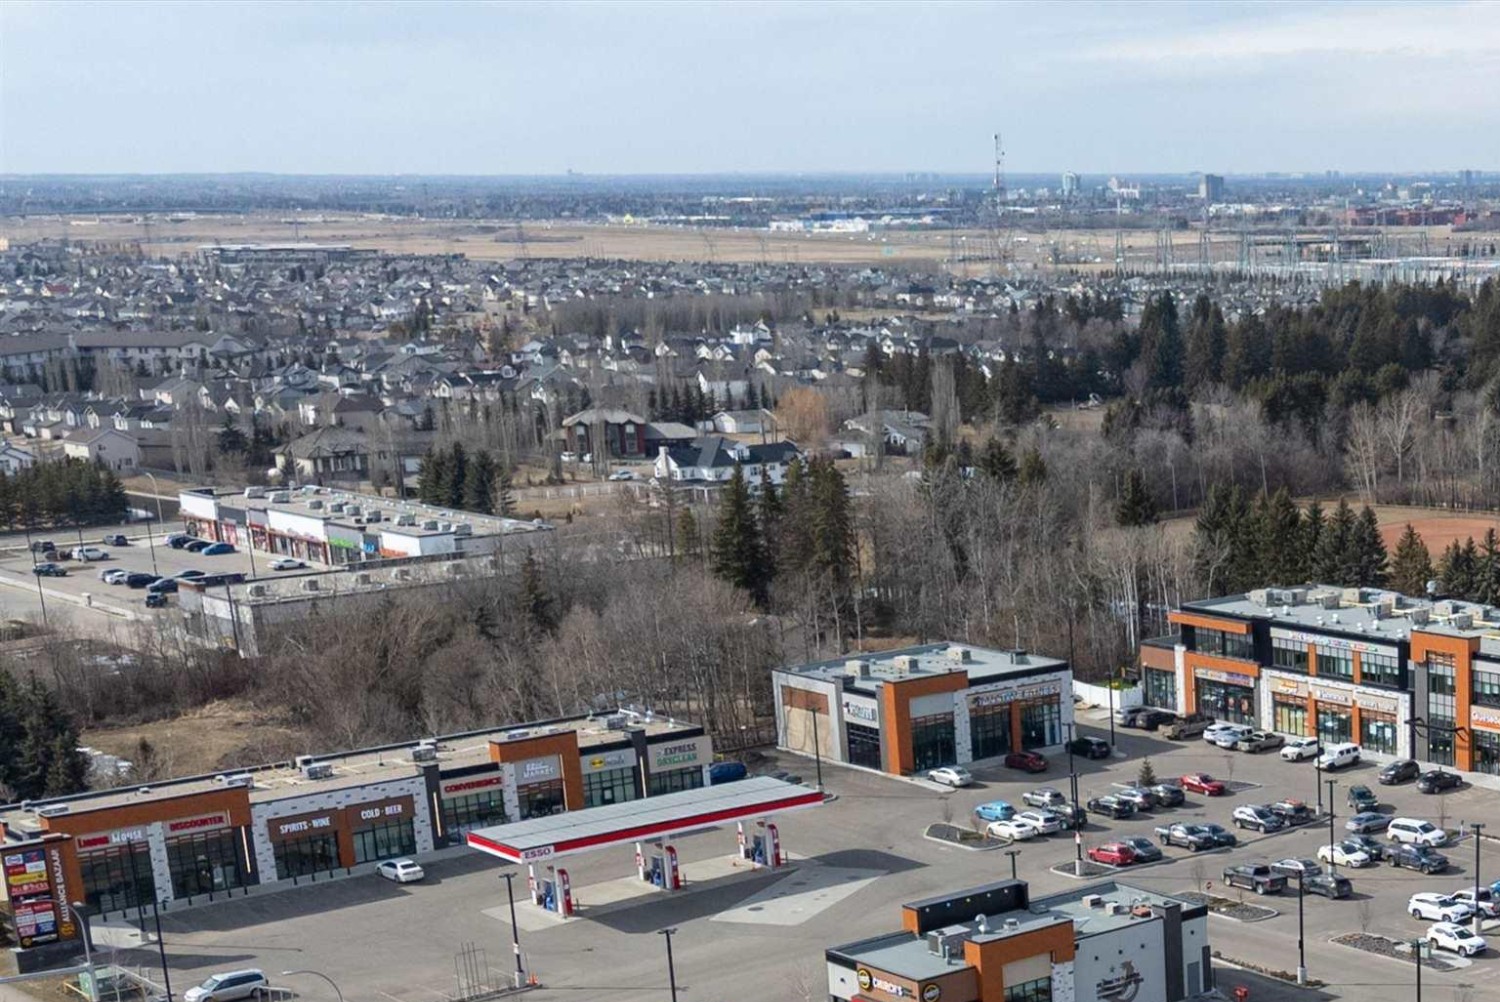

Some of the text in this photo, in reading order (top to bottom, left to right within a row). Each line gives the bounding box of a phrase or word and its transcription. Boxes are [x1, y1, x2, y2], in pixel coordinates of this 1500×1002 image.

[361, 804, 402, 820] COLD BEER
[280, 816, 331, 834] SPIRITS WINE
[524, 847, 551, 859] ESSO
